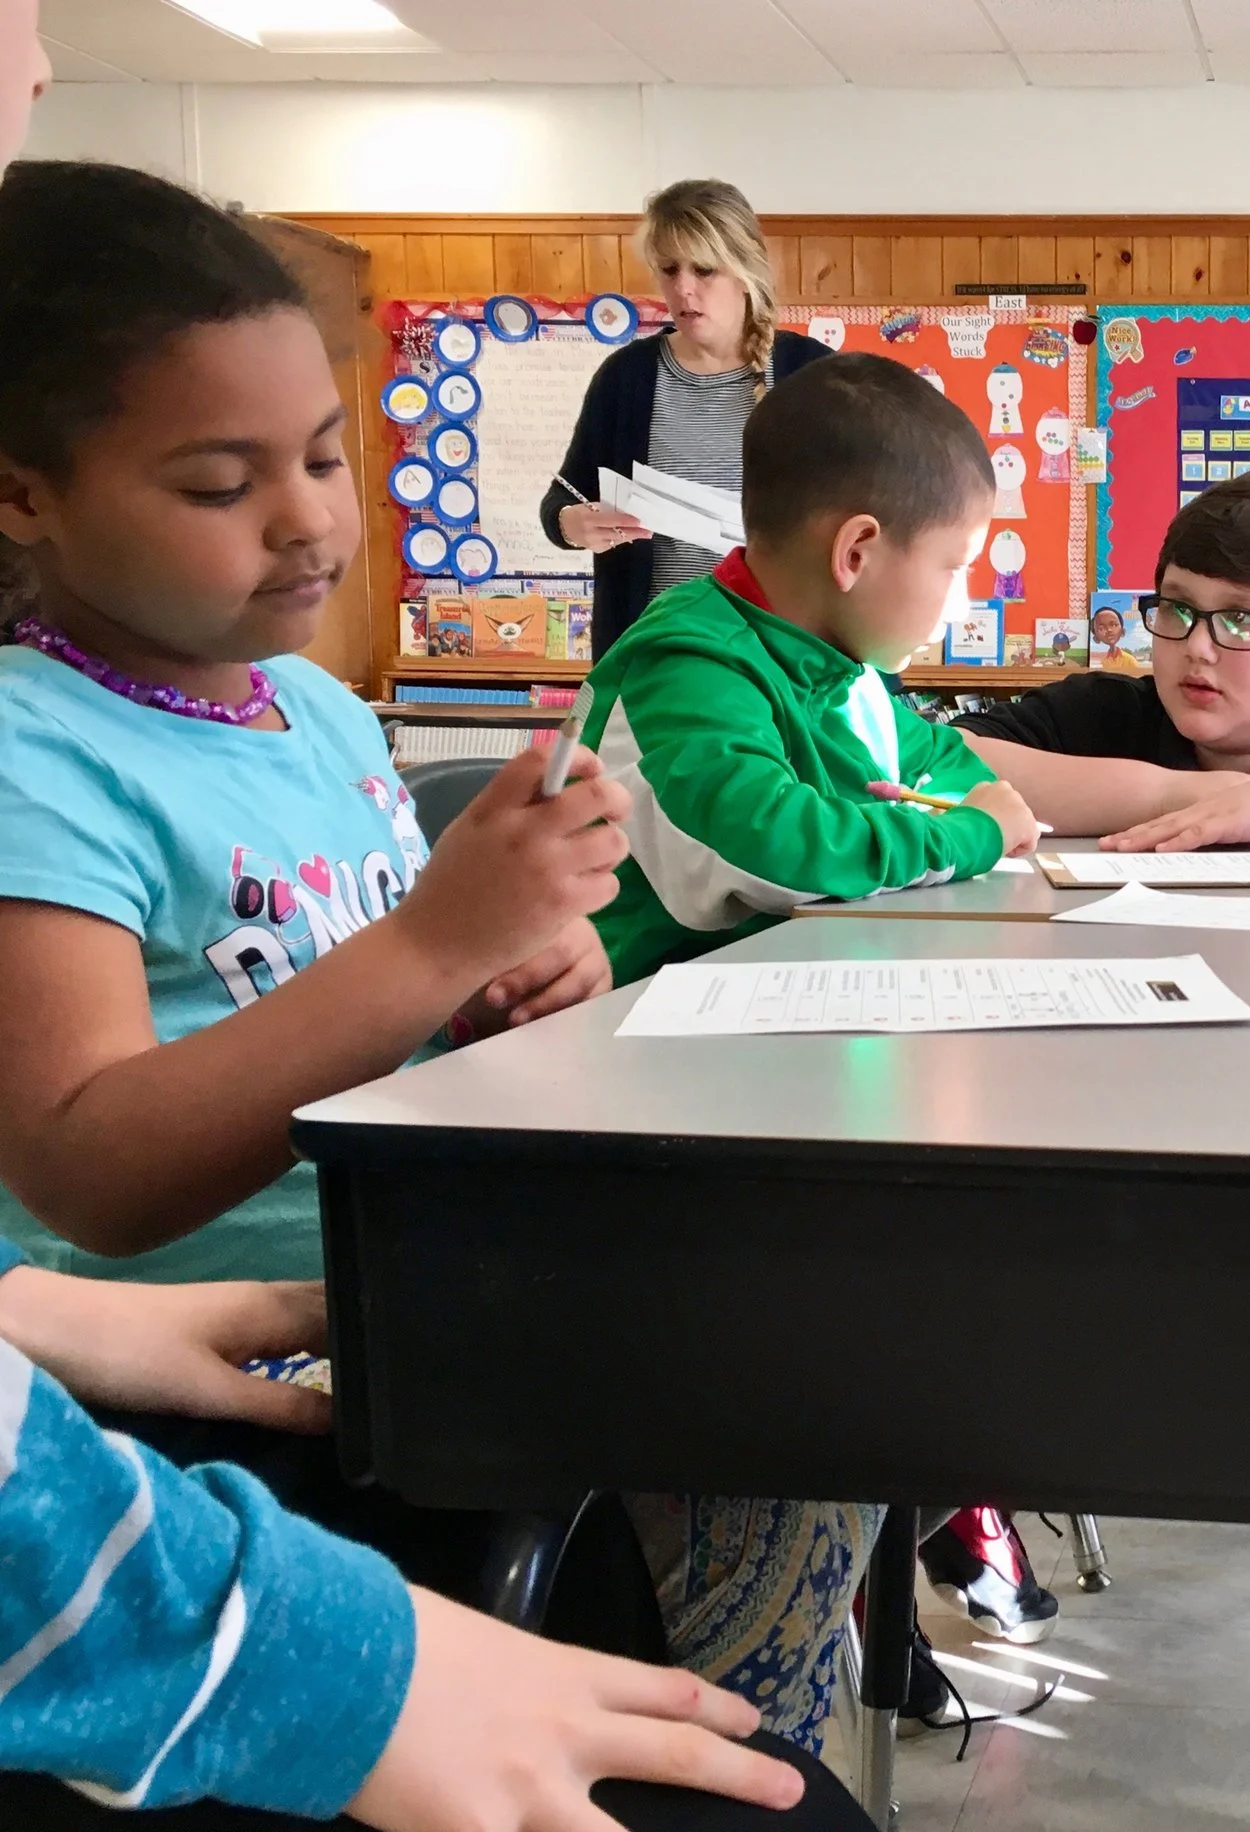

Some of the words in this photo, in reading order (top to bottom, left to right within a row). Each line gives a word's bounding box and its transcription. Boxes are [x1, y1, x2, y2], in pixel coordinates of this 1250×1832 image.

[994, 295, 1024, 309] East
[941, 317, 962, 327] Our
[964, 316, 992, 330] Sight
[1110, 326, 1132, 335] Nice
[949, 331, 985, 342] Words
[952, 346, 983, 357] Stuck
